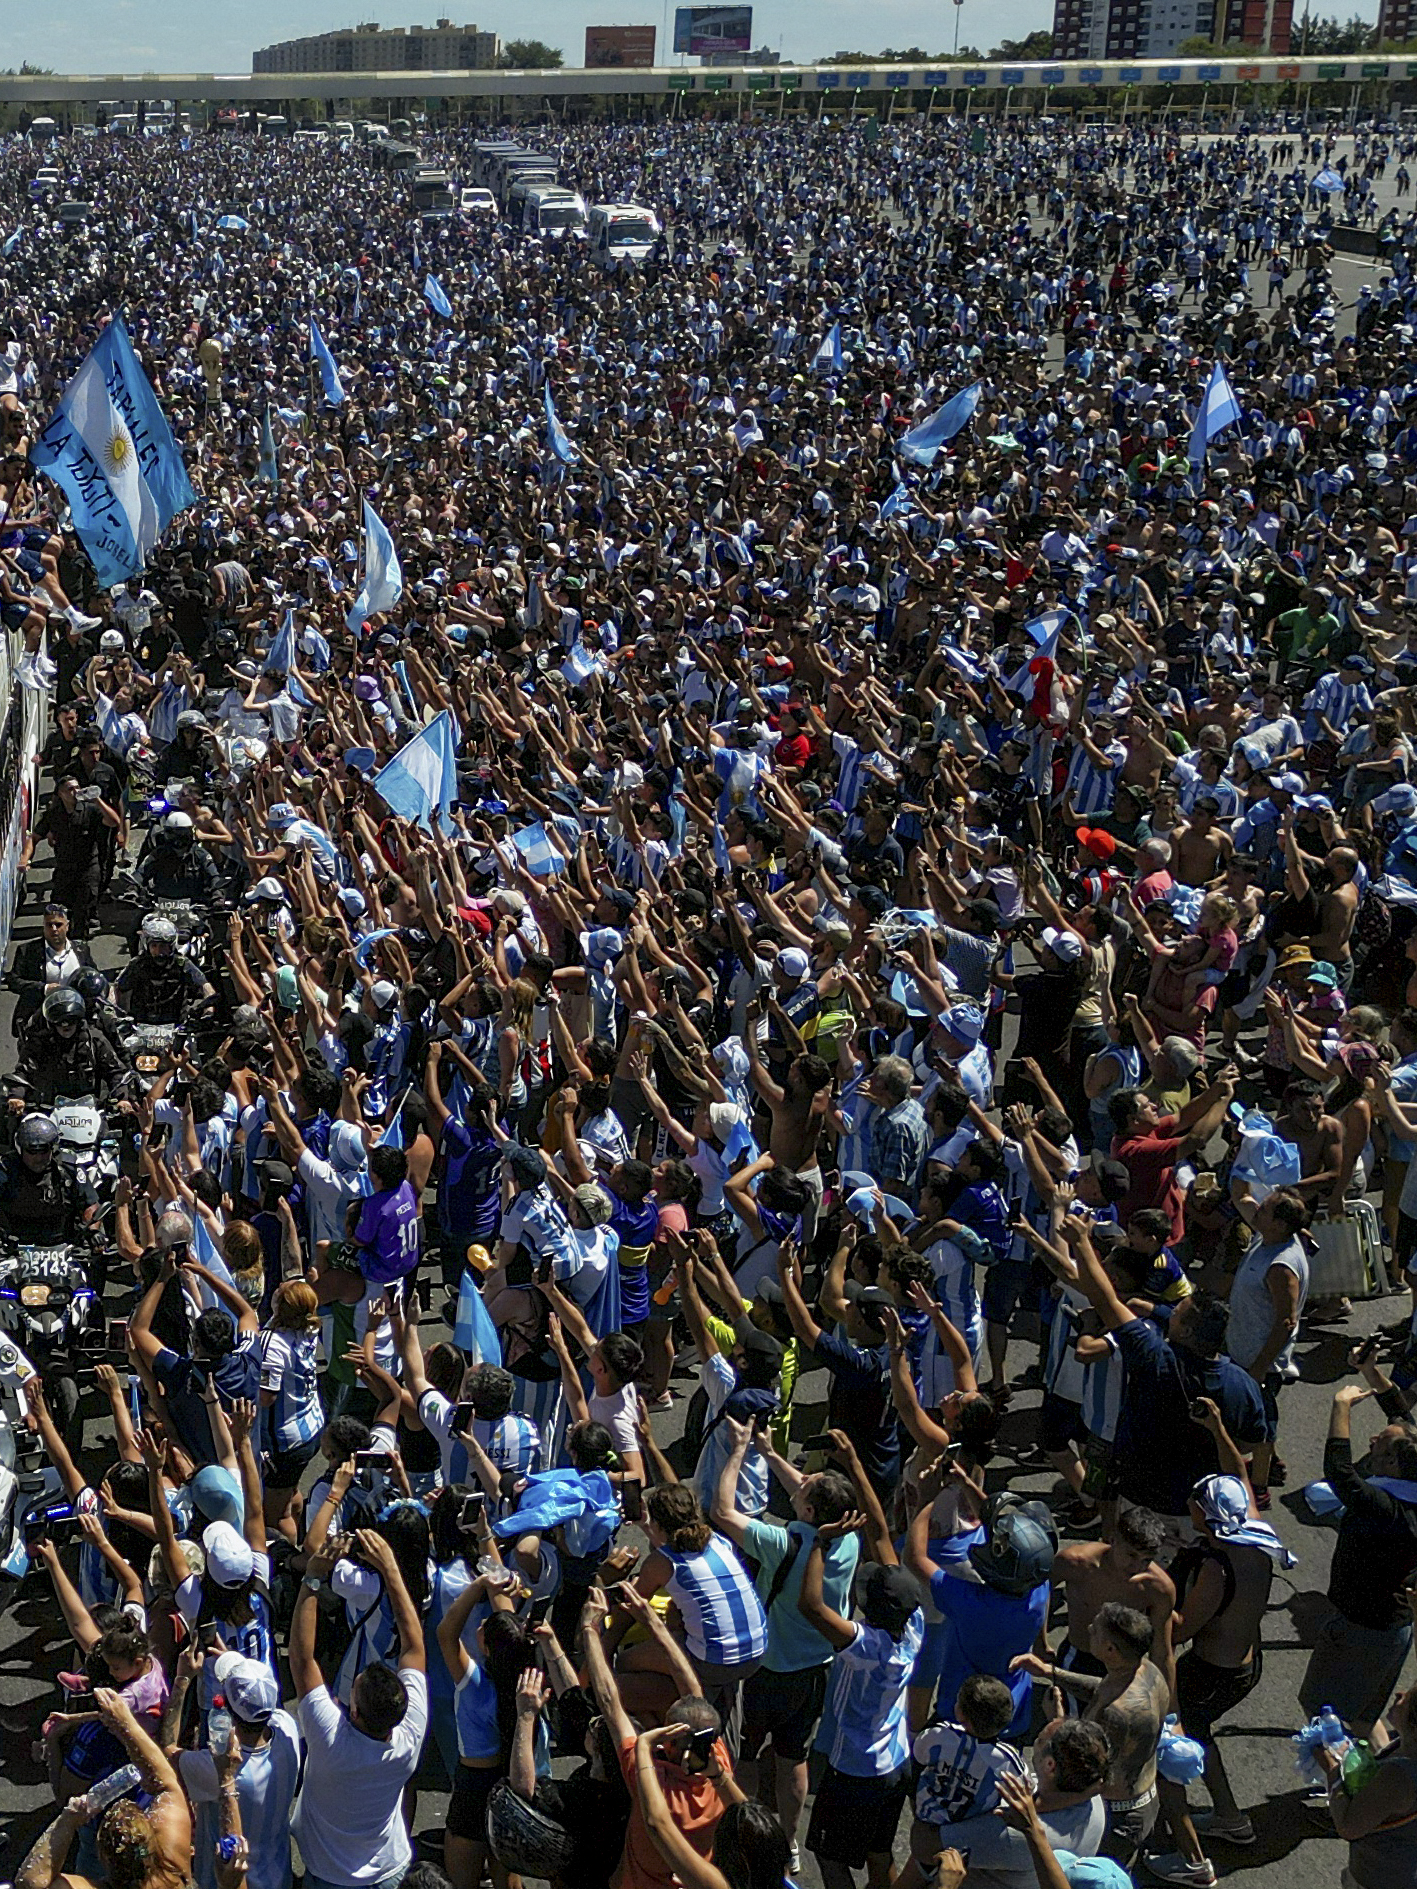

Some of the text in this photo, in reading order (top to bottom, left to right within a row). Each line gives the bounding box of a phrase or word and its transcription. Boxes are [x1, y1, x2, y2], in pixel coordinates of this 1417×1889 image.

[41, 414, 73, 457] LA
[397, 1218, 418, 1258] 10
[21, 1260, 68, 1278] 25143
[485, 1448, 511, 1459] ESSI
